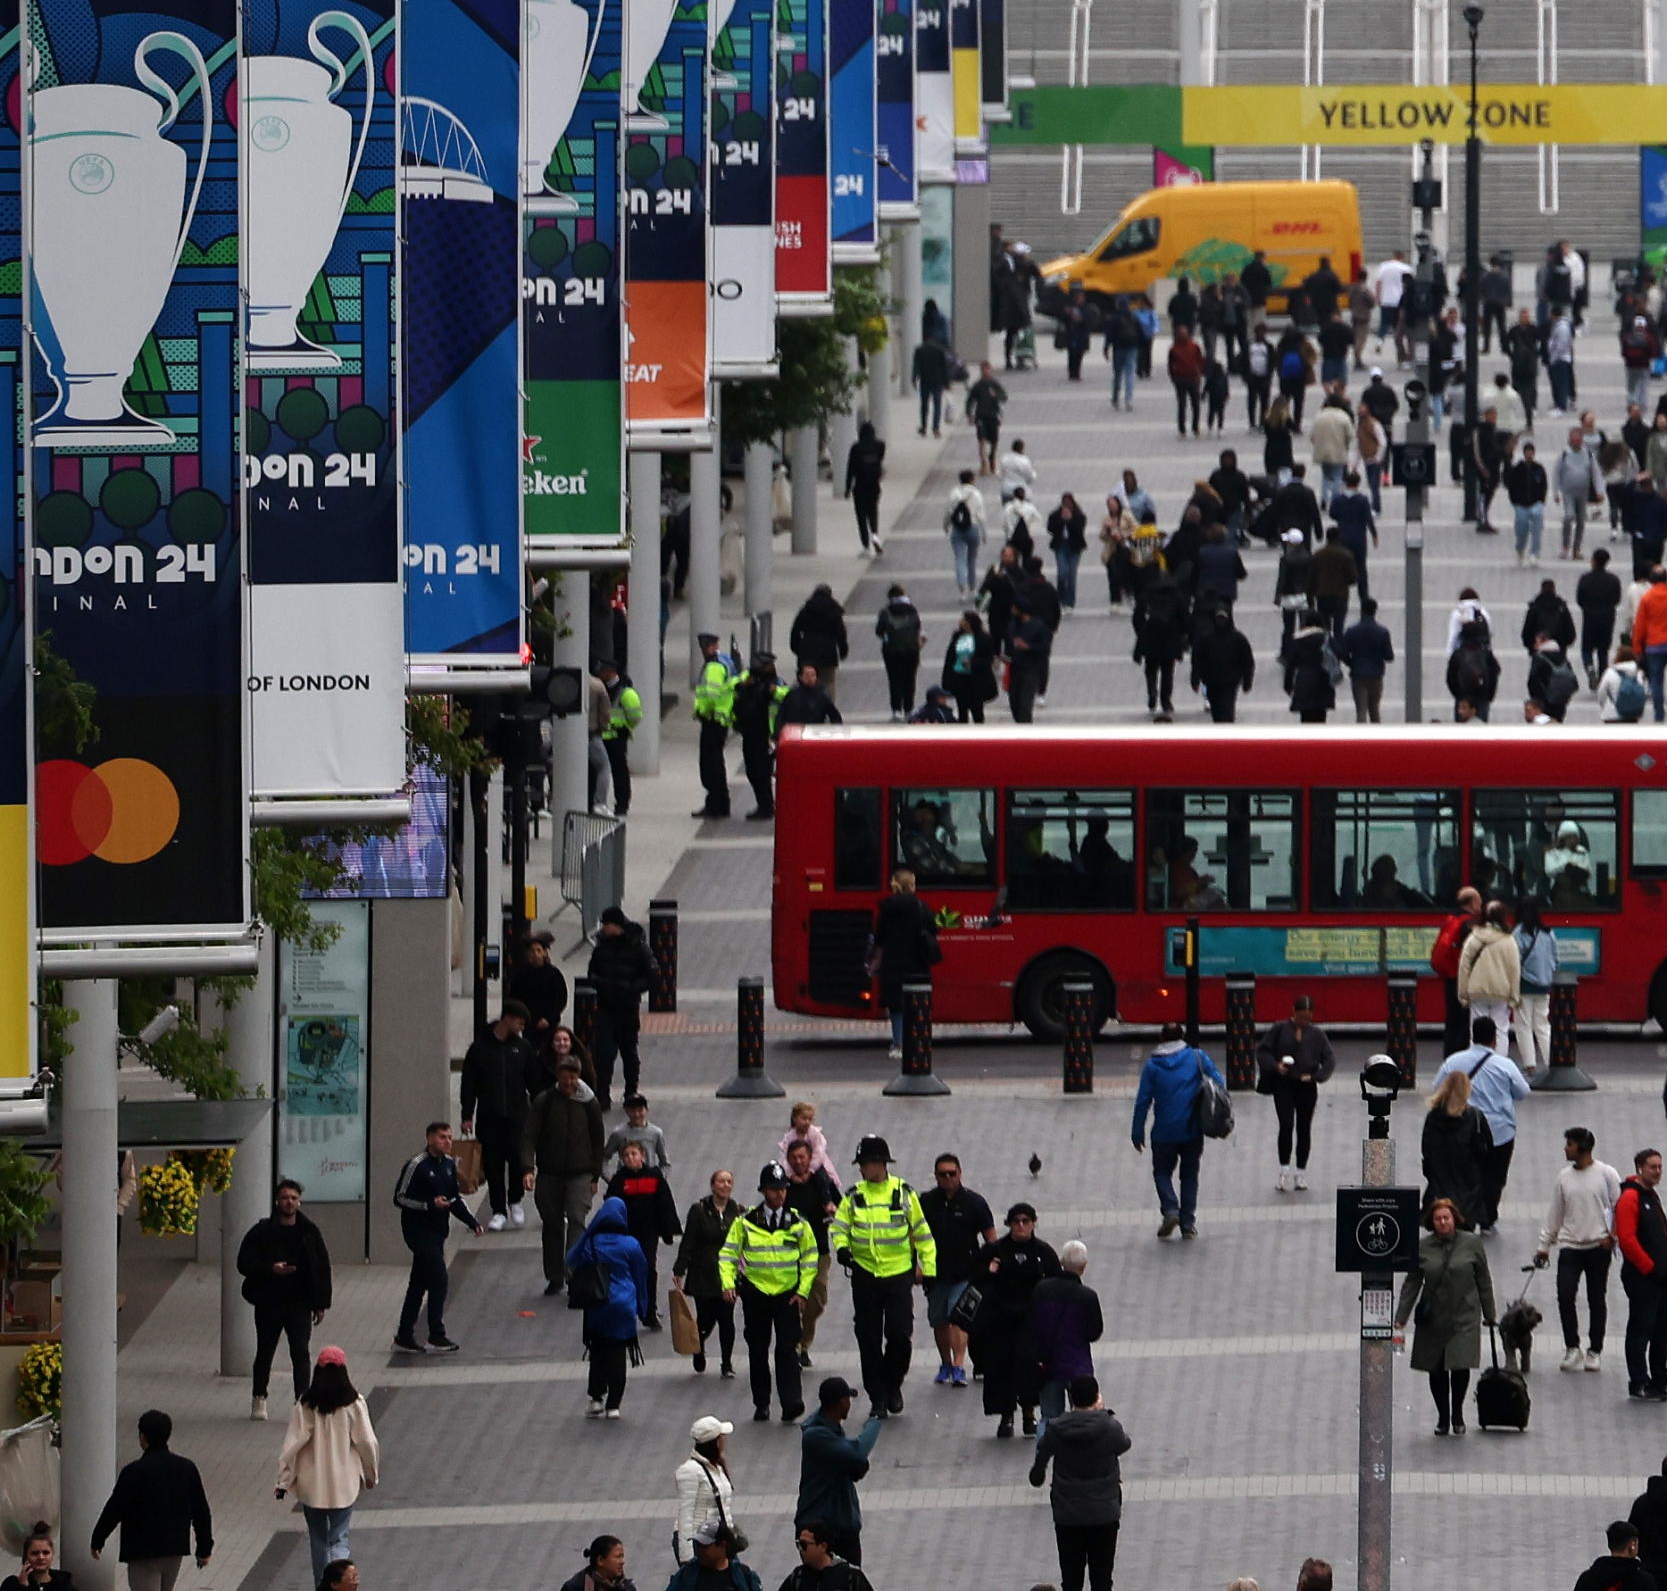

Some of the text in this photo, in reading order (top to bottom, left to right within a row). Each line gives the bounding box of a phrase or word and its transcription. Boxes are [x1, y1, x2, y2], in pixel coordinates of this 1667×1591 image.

[784, 98, 816, 121] 24
[1319, 102, 1551, 129] YELLOW ZONE
[725, 141, 760, 166] 24
[834, 175, 864, 197] 24
[655, 188, 692, 215] 24
[564, 278, 605, 306] 24
[324, 452, 377, 487] 24
[523, 469, 588, 495] eken
[260, 497, 326, 510] NAL
[156, 543, 216, 583] 24
[455, 544, 500, 575] 24
[53, 594, 158, 610] INAL
[247, 674, 371, 693] OF LONDON
